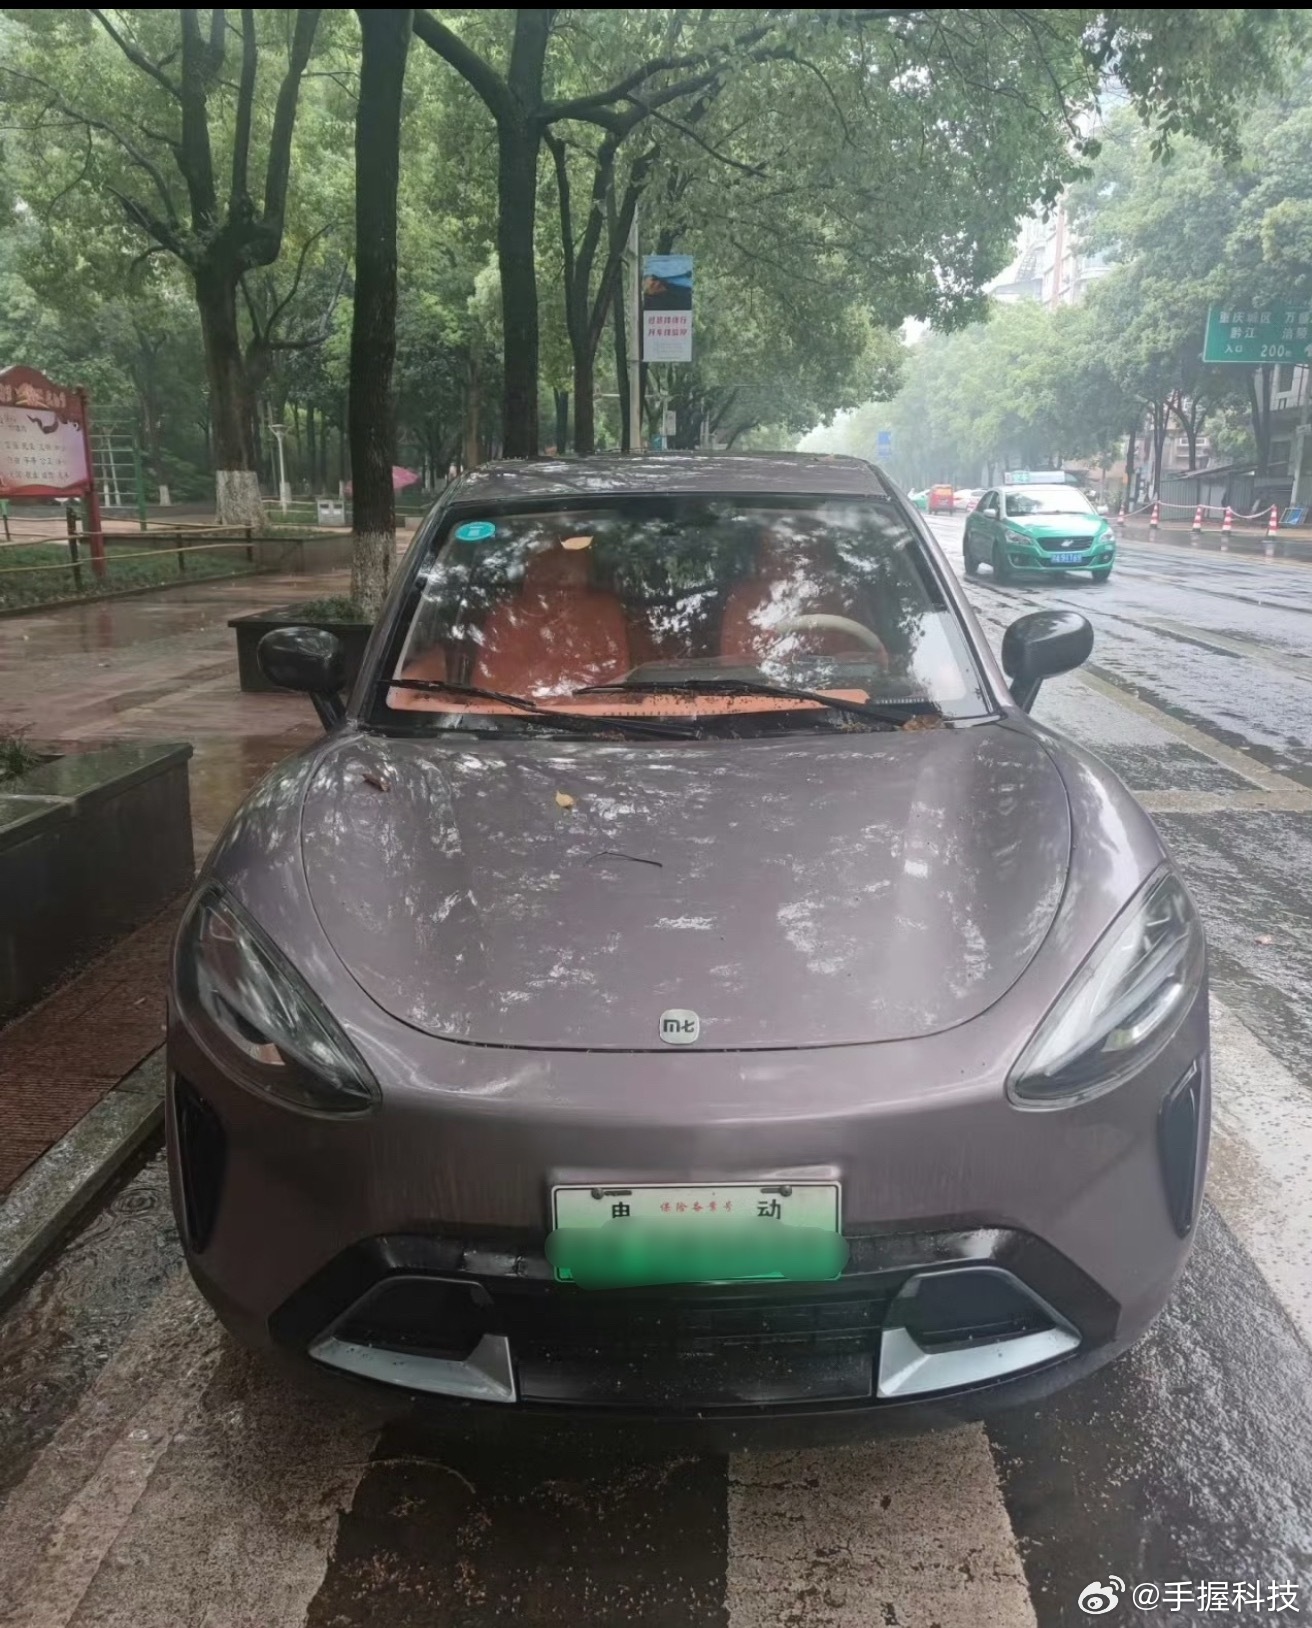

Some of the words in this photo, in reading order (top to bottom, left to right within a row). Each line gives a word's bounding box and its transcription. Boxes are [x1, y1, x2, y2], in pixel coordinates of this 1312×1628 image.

[1224, 344, 1243, 354] 入口
[660, 1200, 733, 1213] 保险备案号
[757, 1199, 782, 1220] 动
